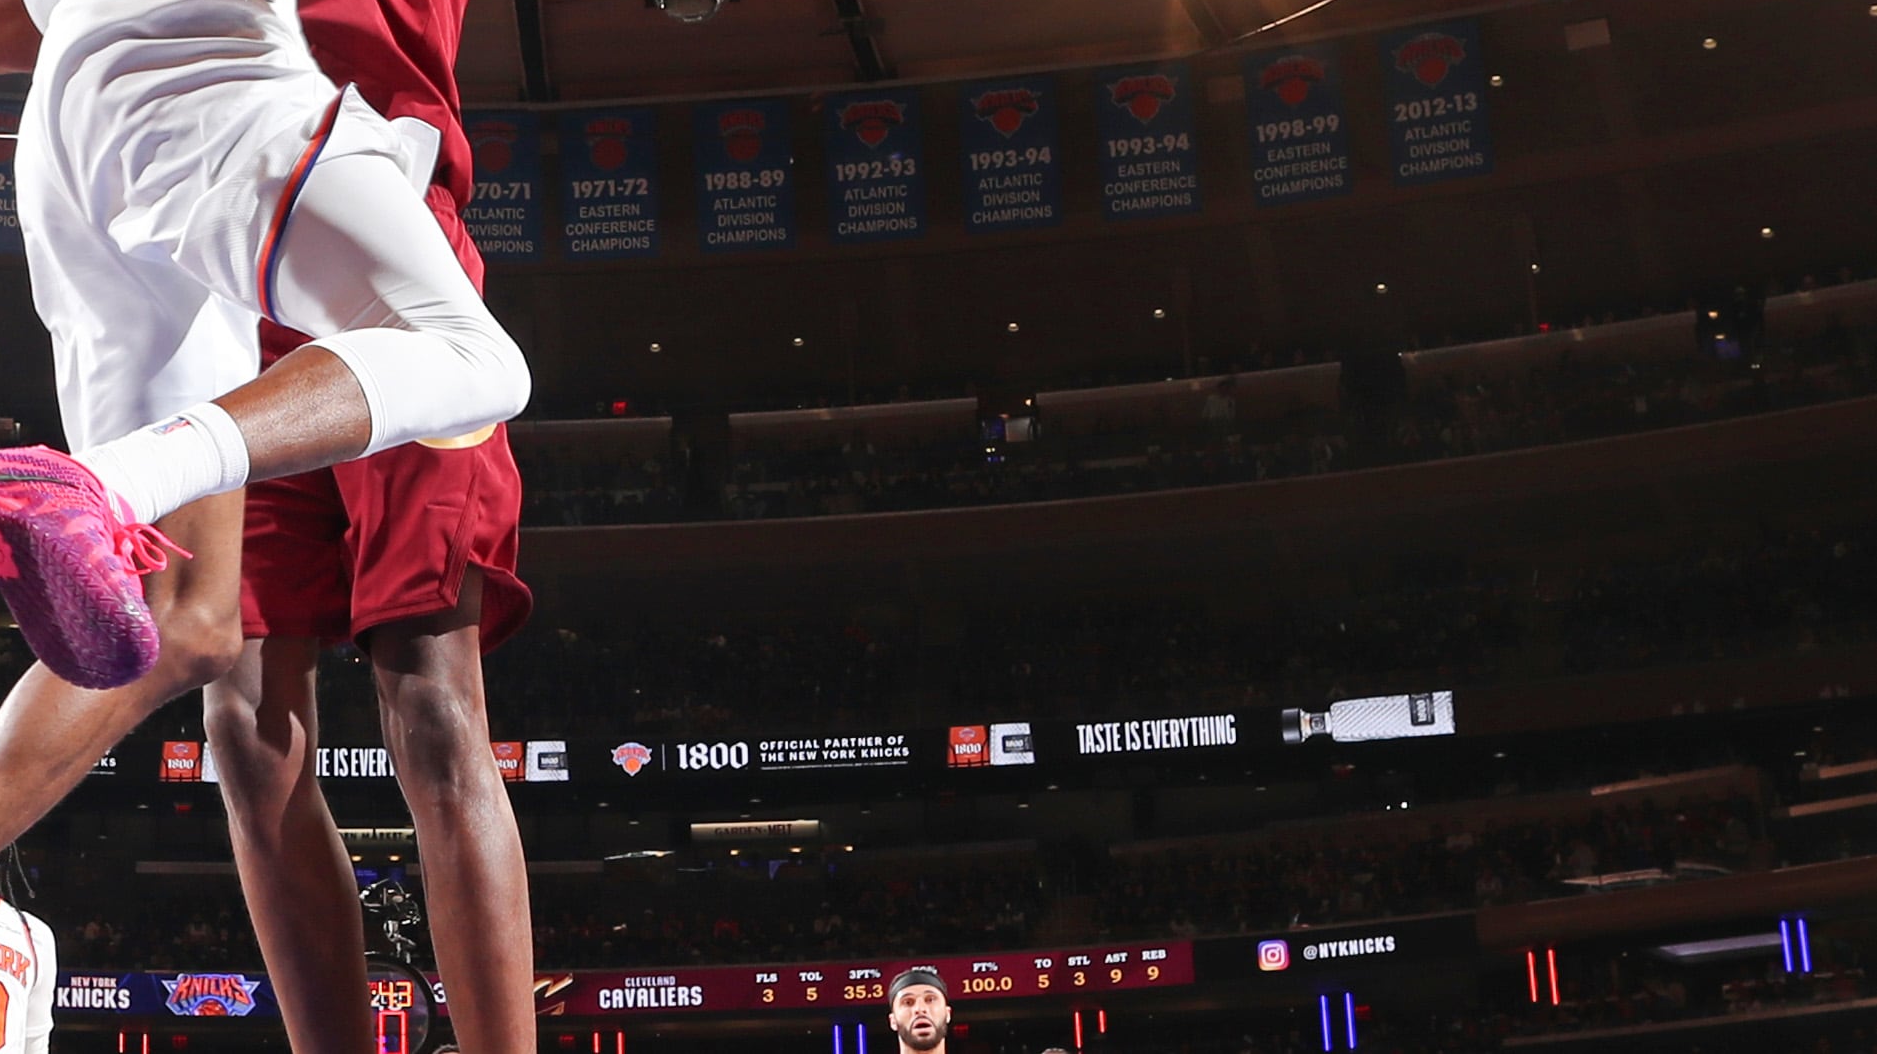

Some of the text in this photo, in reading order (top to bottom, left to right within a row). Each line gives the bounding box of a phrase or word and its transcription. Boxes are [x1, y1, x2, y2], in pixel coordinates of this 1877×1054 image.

[1394, 92, 1478, 122] 2012-13
[1256, 114, 1340, 143] 1998-99
[1404, 120, 1472, 142] ATLANTIC
[1108, 133, 1190, 158] 1993-94
[1267, 142, 1331, 163] EASTERN
[1409, 138, 1470, 158] DIVISION
[970, 146, 1052, 171] 1993-94
[1118, 159, 1180, 178] EASTERN
[1399, 152, 1484, 177] CHAMPIONS
[836, 158, 917, 182] 1992-93
[1254, 156, 1347, 182] CONFERENCE
[473, 182, 532, 200] 70-71
[571, 178, 649, 198] 1971-72
[704, 170, 785, 192] 1988-89
[978, 173, 1042, 190] ATLANTIC
[1104, 176, 1196, 196] CONFERENCE
[1261, 174, 1344, 198] CHAMPIONS
[713, 195, 777, 211] ATLANTIC
[844, 185, 908, 202] ATLANTIC
[982, 190, 1040, 207] DIVISION
[1111, 193, 1192, 212] CHAMPIONS
[463, 208, 525, 220] ATLANTIC
[579, 203, 640, 218] EASTERN
[718, 211, 775, 227] DIVISION
[848, 202, 905, 218] DIVISION
[972, 206, 1054, 224] CHAMPIONS
[565, 219, 655, 236] CONFERENCE
[707, 228, 786, 244] CHAMPIONS
[838, 218, 918, 236] CHAMPIONS
[572, 236, 650, 252] CHAMPIONS
[760, 735, 905, 752] OFFICIAL PARTNER OF
[1076, 714, 1237, 754] TASTE IS EVERYTHING
[676, 741, 750, 771] 1800
[760, 746, 910, 764] THE NEW YORK KNICKS
[954, 742, 982, 755] 1800
[168, 758, 194, 769] 1800
[334, 748, 349, 777] IS
[1302, 936, 1396, 961] @NYKNICKS
[756, 948, 1166, 983] FLS TOL 3PT% FT% TO STL AST REB
[71, 976, 117, 988] NEW YORK
[171, 976, 251, 1005] KNICKS
[624, 976, 676, 987] CLEVELAND
[762, 966, 1160, 1002] 3 5 35.3 100.0 5 3 9 9
[57, 986, 131, 1009] KNICKS
[599, 986, 703, 1009] CAVALIERS
